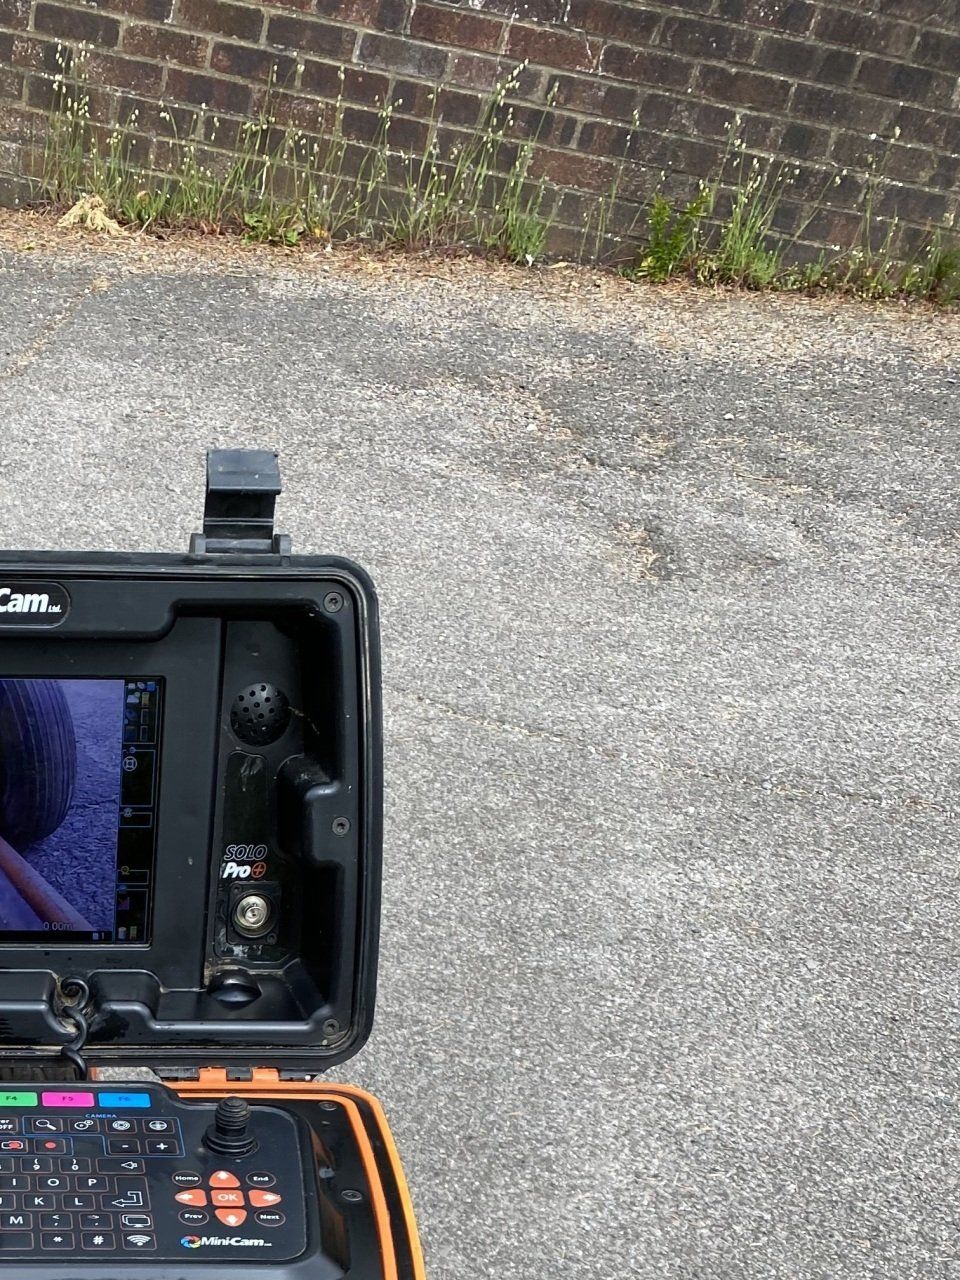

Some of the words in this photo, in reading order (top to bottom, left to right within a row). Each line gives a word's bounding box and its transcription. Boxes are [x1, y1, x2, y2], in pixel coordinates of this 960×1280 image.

[224, 844, 268, 860] SOLO
[222, 862, 251, 878] Pro
[48, 1178, 60, 1186] O
[88, 1178, 97, 1186] P
[34, 1197, 44, 1205] K
[74, 1198, 83, 1206] L
[218, 1194, 238, 1202] OK
[9, 1216, 24, 1224] M
